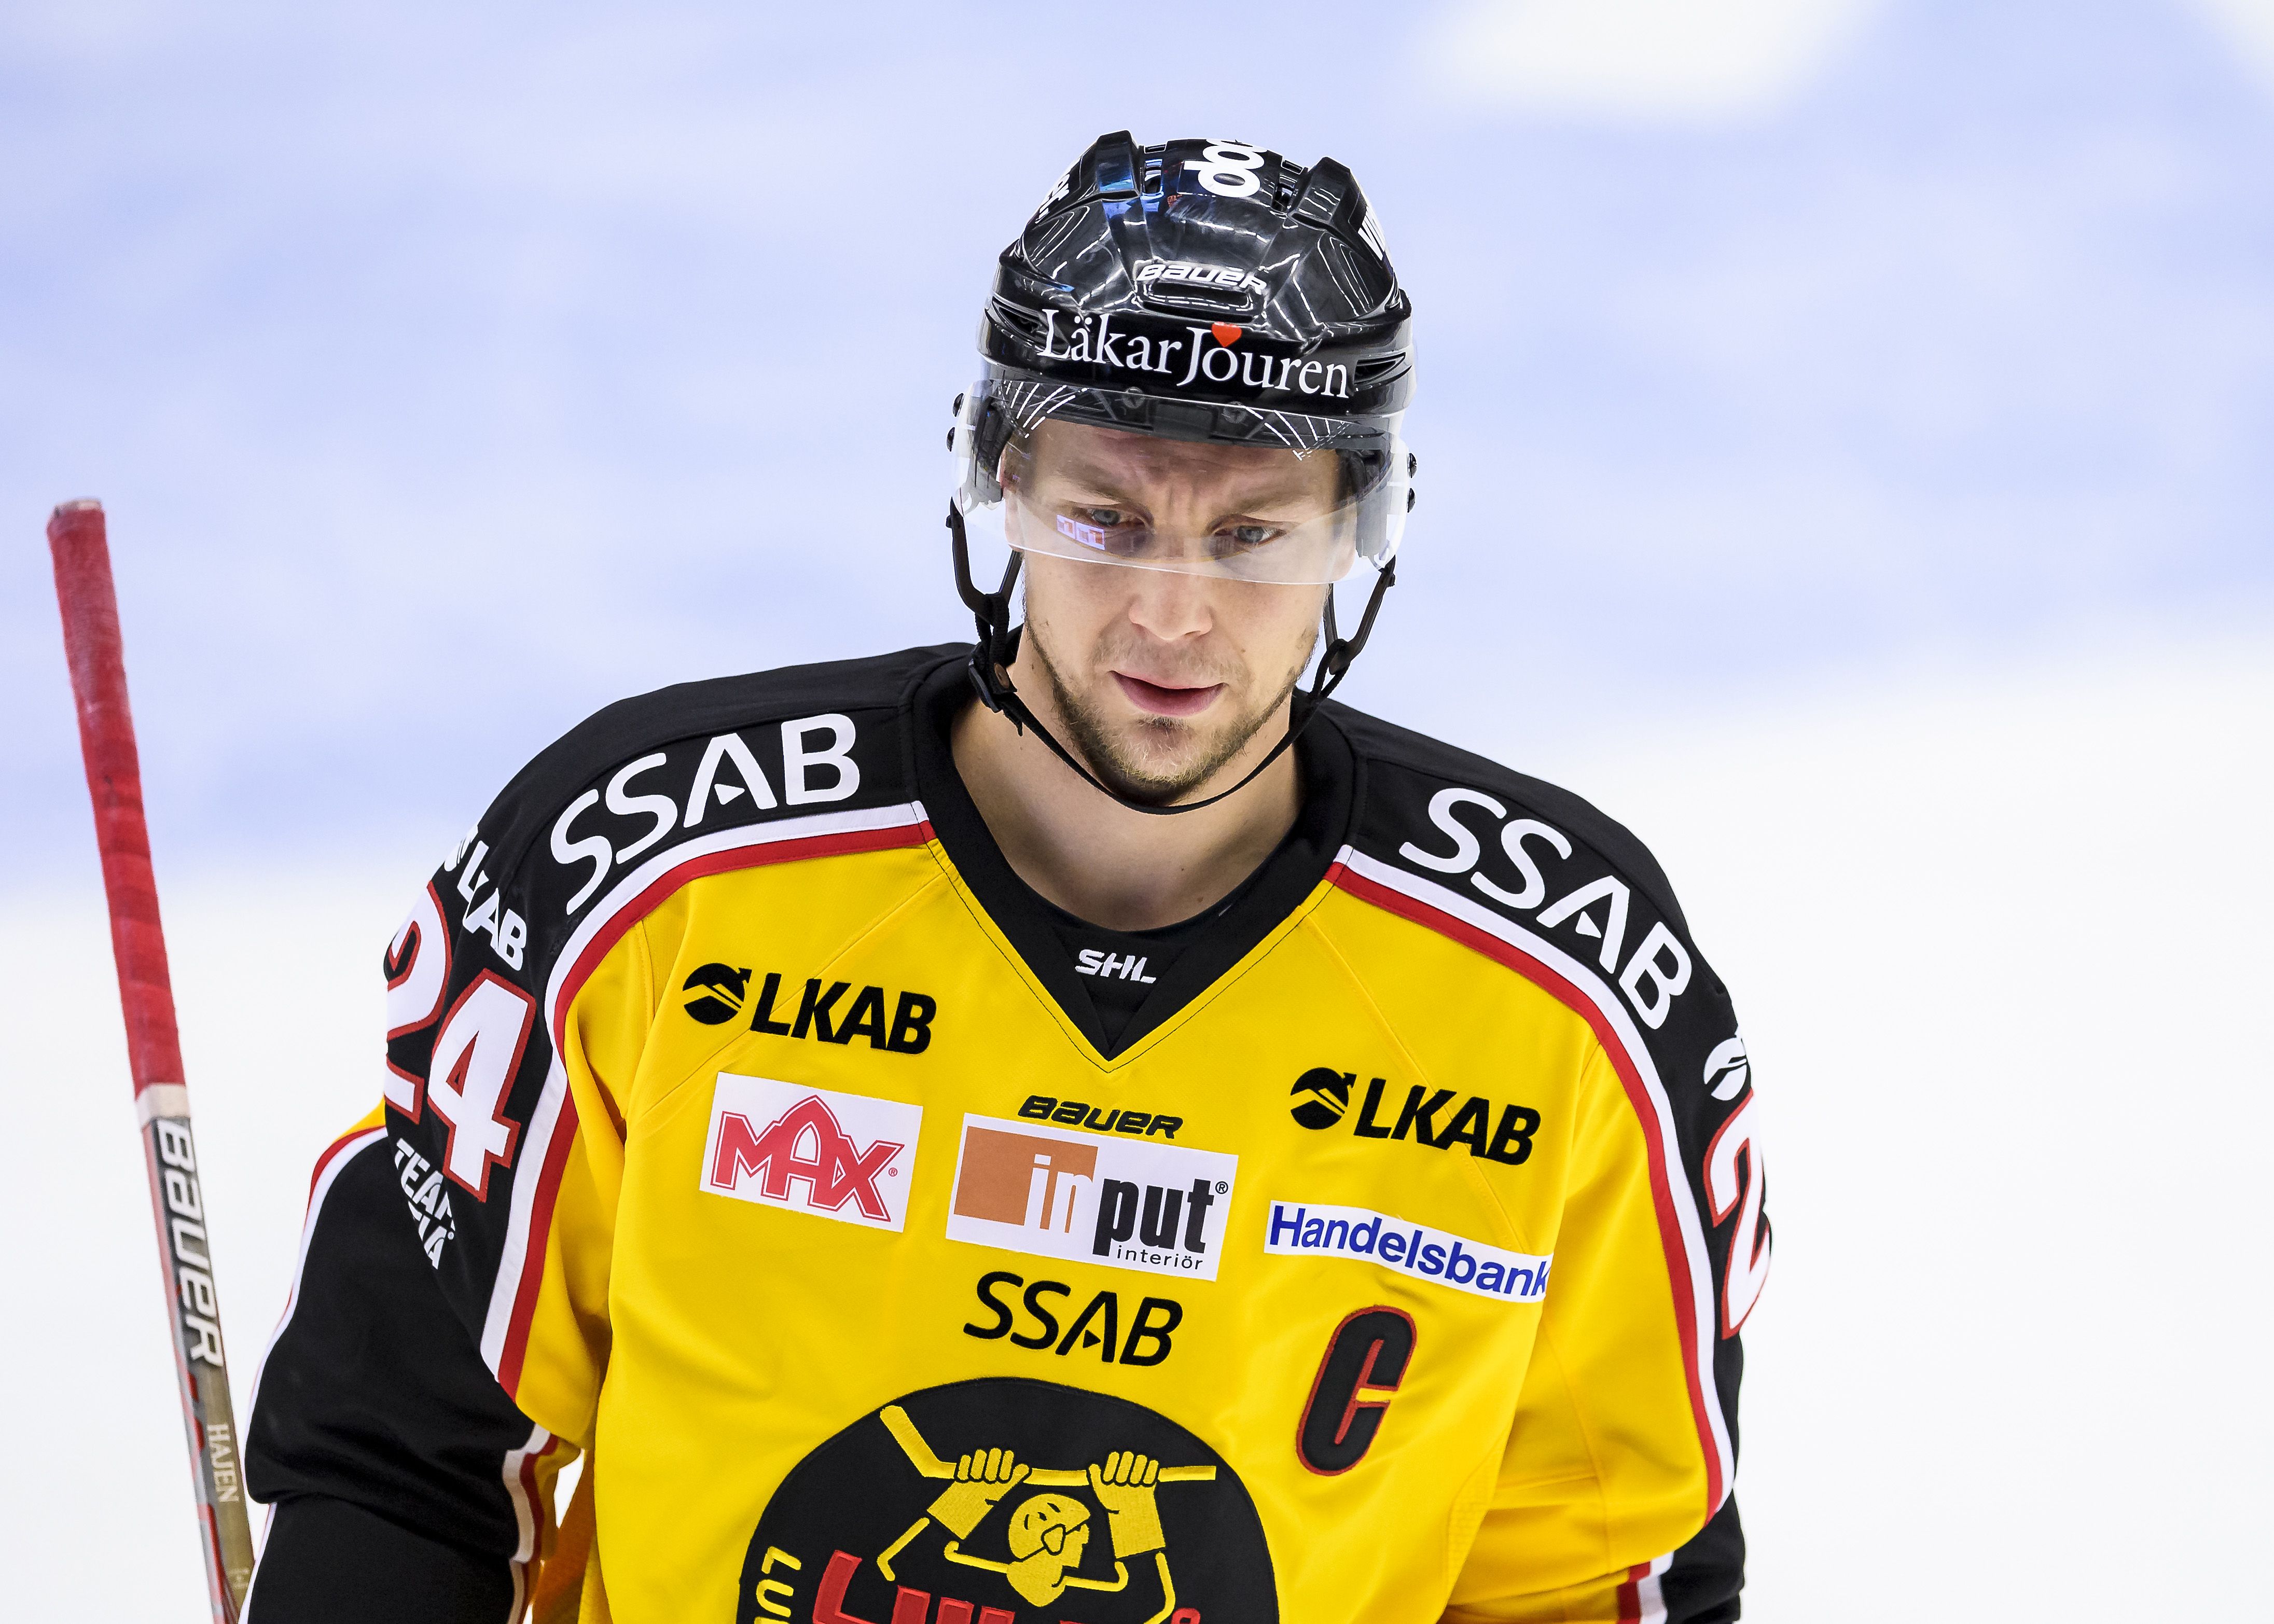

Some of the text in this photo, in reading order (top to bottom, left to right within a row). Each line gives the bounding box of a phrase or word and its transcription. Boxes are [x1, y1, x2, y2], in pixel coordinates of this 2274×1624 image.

[1136, 264, 1267, 295] BAUER
[551, 714, 859, 915] SSAB
[1399, 788, 1692, 1030] SSAB
[1075, 949, 1156, 983] SHL
[384, 881, 536, 1203] 24
[750, 972, 937, 1054] LKAB
[710, 1094, 905, 1222] MAX
[1018, 1095, 1183, 1139] BAUER
[1354, 1078, 1541, 1165] LKAB
[157, 1118, 224, 1368] BAUER
[1117, 1245, 1203, 1270] interiör
[963, 1271, 1183, 1367] SSAB
[1296, 1305, 1417, 1477] C
[207, 1422, 239, 1503] HAJEN
